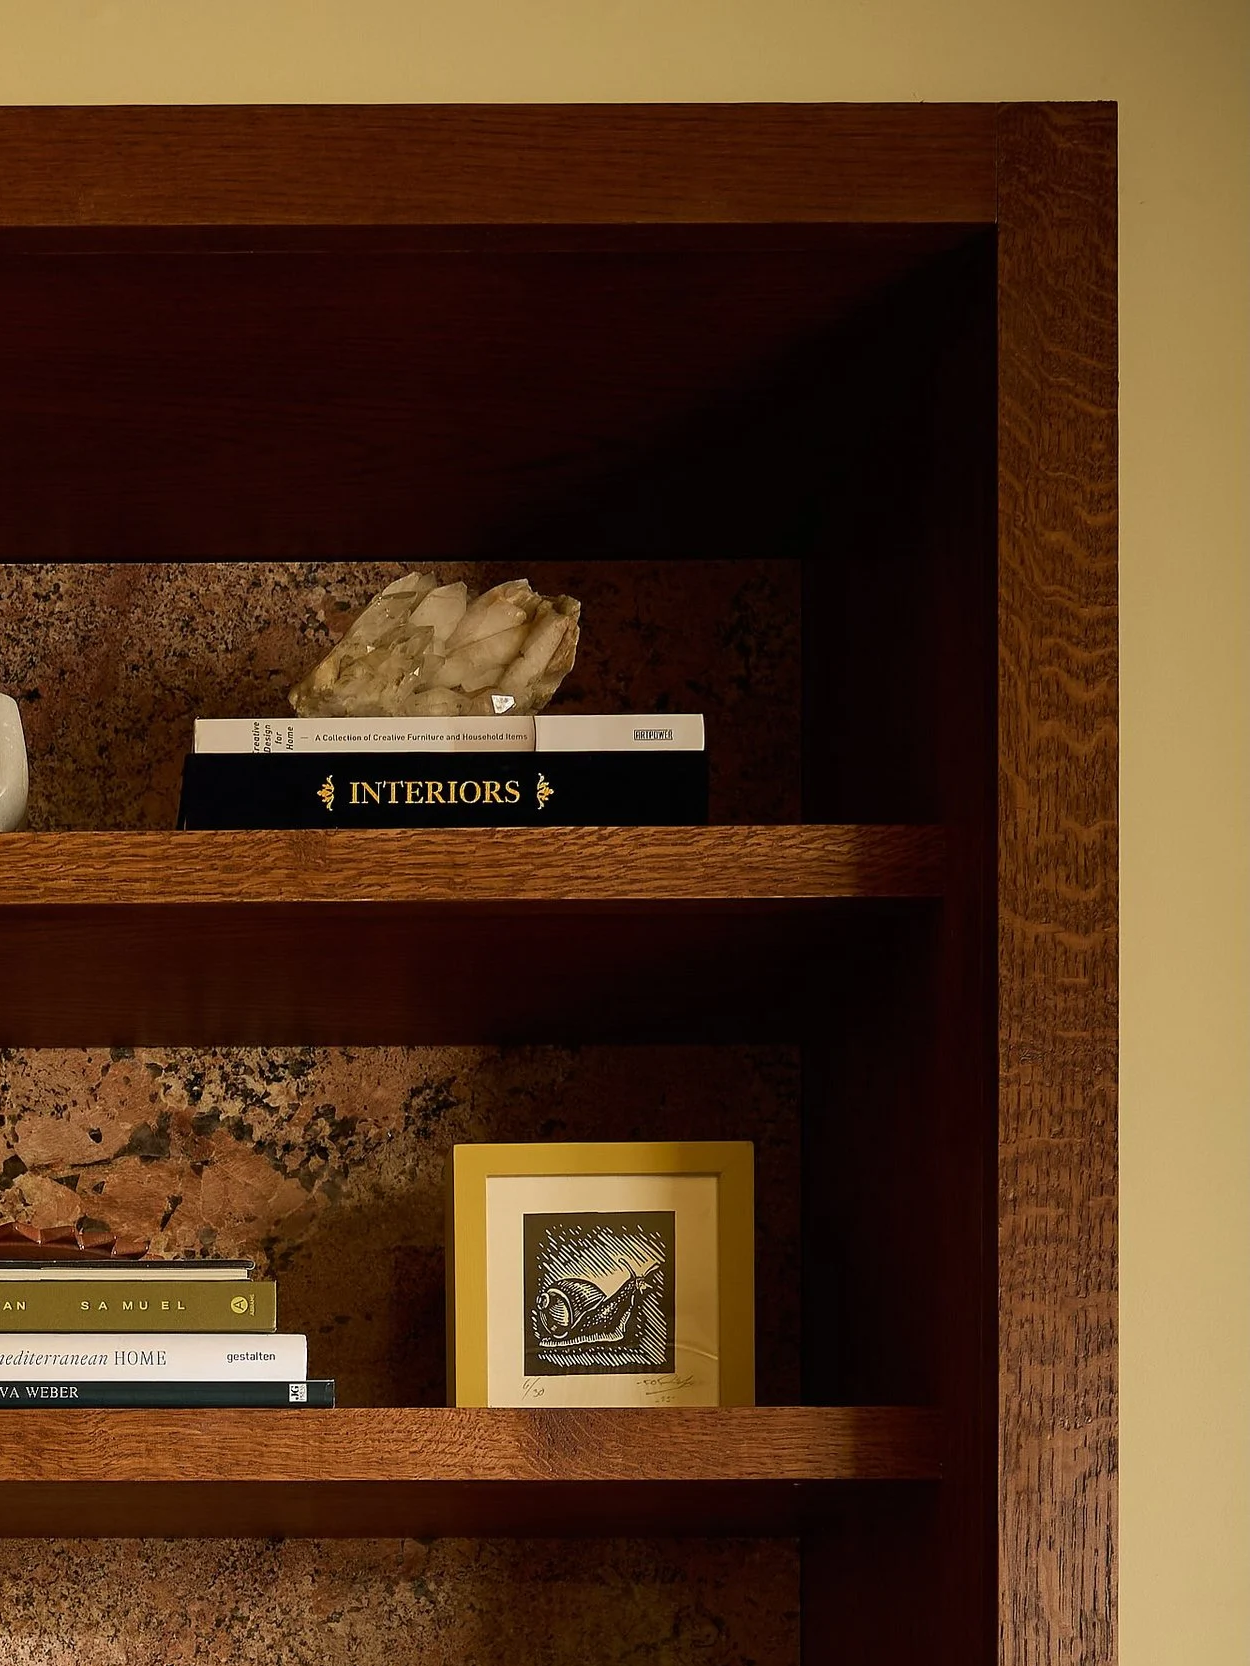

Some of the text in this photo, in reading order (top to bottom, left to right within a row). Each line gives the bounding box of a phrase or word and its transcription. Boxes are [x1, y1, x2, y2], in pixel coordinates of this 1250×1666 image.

[263, 724, 273, 753] Design
[275, 731, 283, 744] for
[286, 726, 294, 750] Home
[315, 733, 528, 741] A Collection of Creative Furniture and Household Items
[634, 729, 674, 741] ARTPOWER
[349, 780, 520, 804] INTERIORS
[80, 1300, 186, 1310] SAMUEL
[114, 1350, 167, 1366] HOME
[226, 1352, 276, 1363] gestalten
[25, 1386, 79, 1399] WEBER
